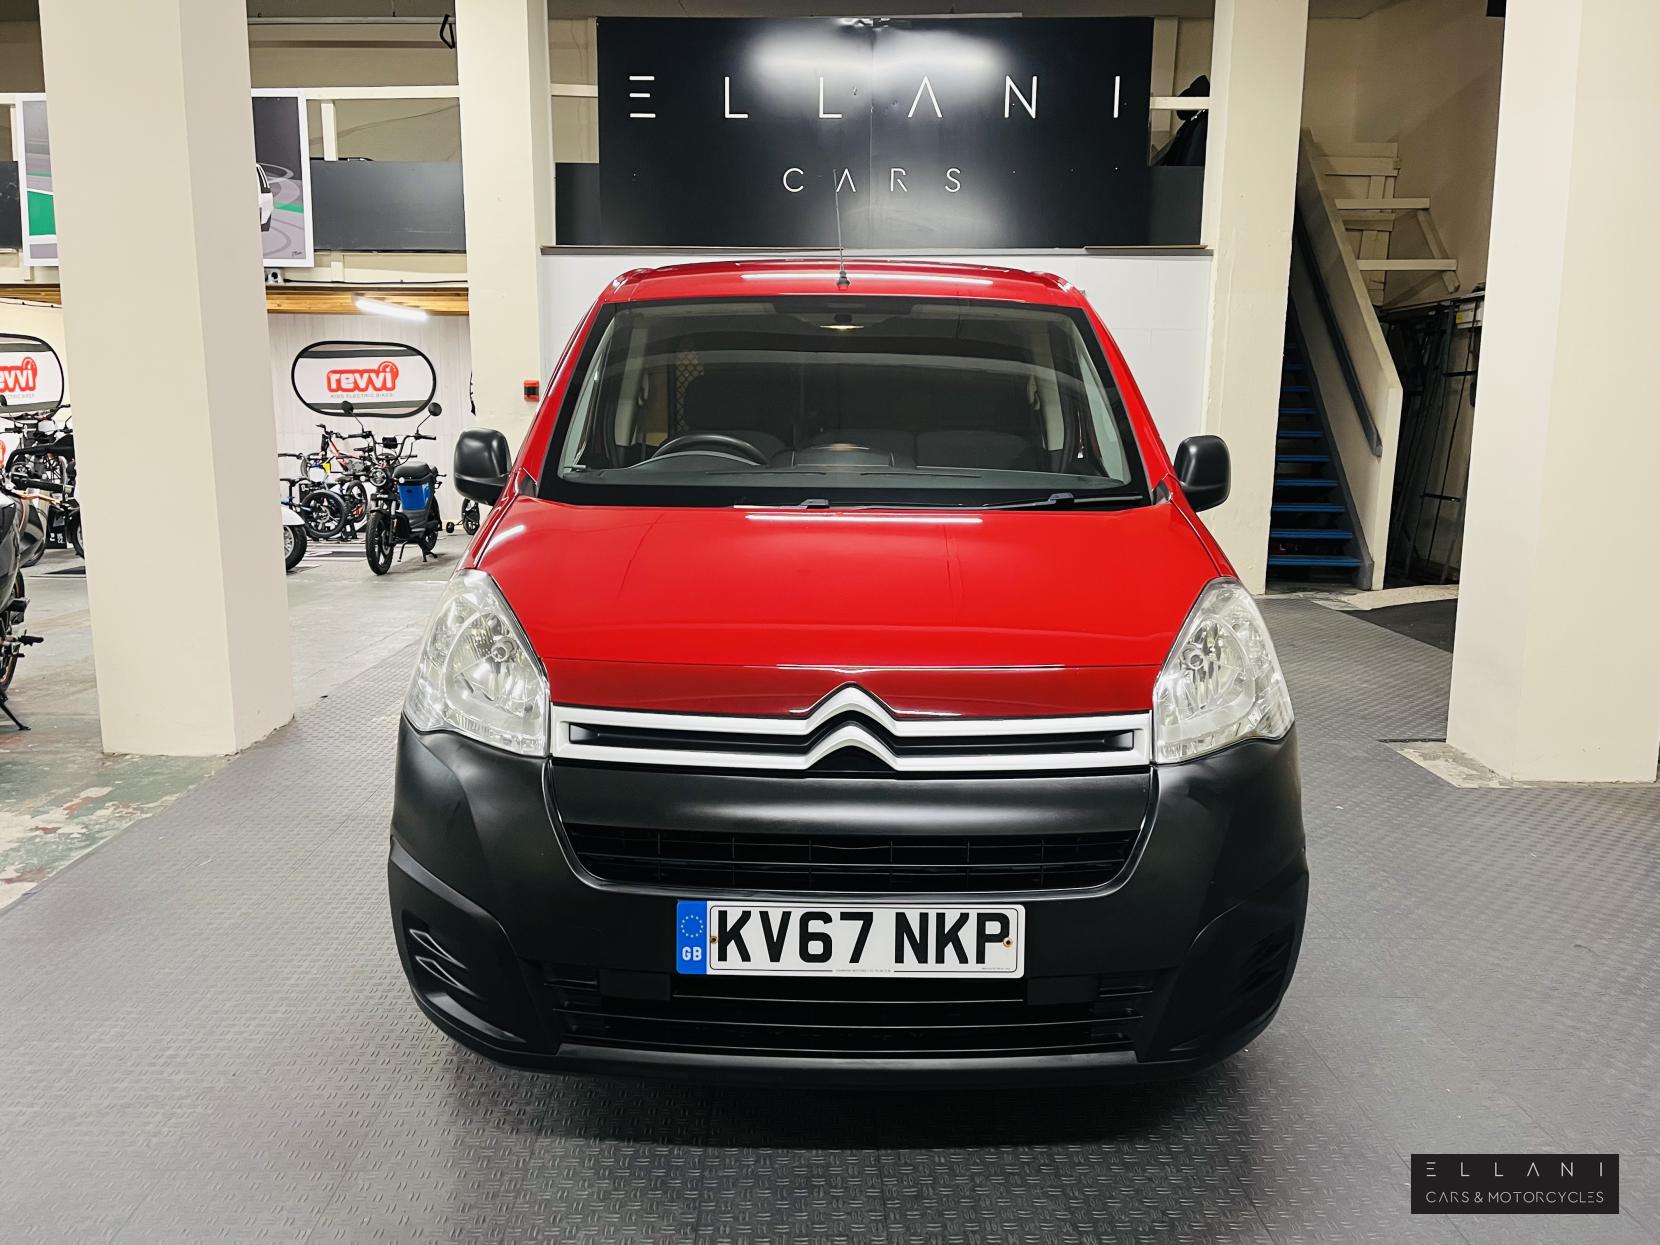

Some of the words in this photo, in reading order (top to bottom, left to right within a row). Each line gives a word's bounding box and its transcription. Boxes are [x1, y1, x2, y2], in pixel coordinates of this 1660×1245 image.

[628, 75, 1121, 119] ELLANI
[782, 167, 961, 193] CARS
[328, 362, 397, 391] revvi
[717, 909, 875, 964] KV67
[894, 909, 1010, 965] NKP
[682, 946, 702, 961] GB
